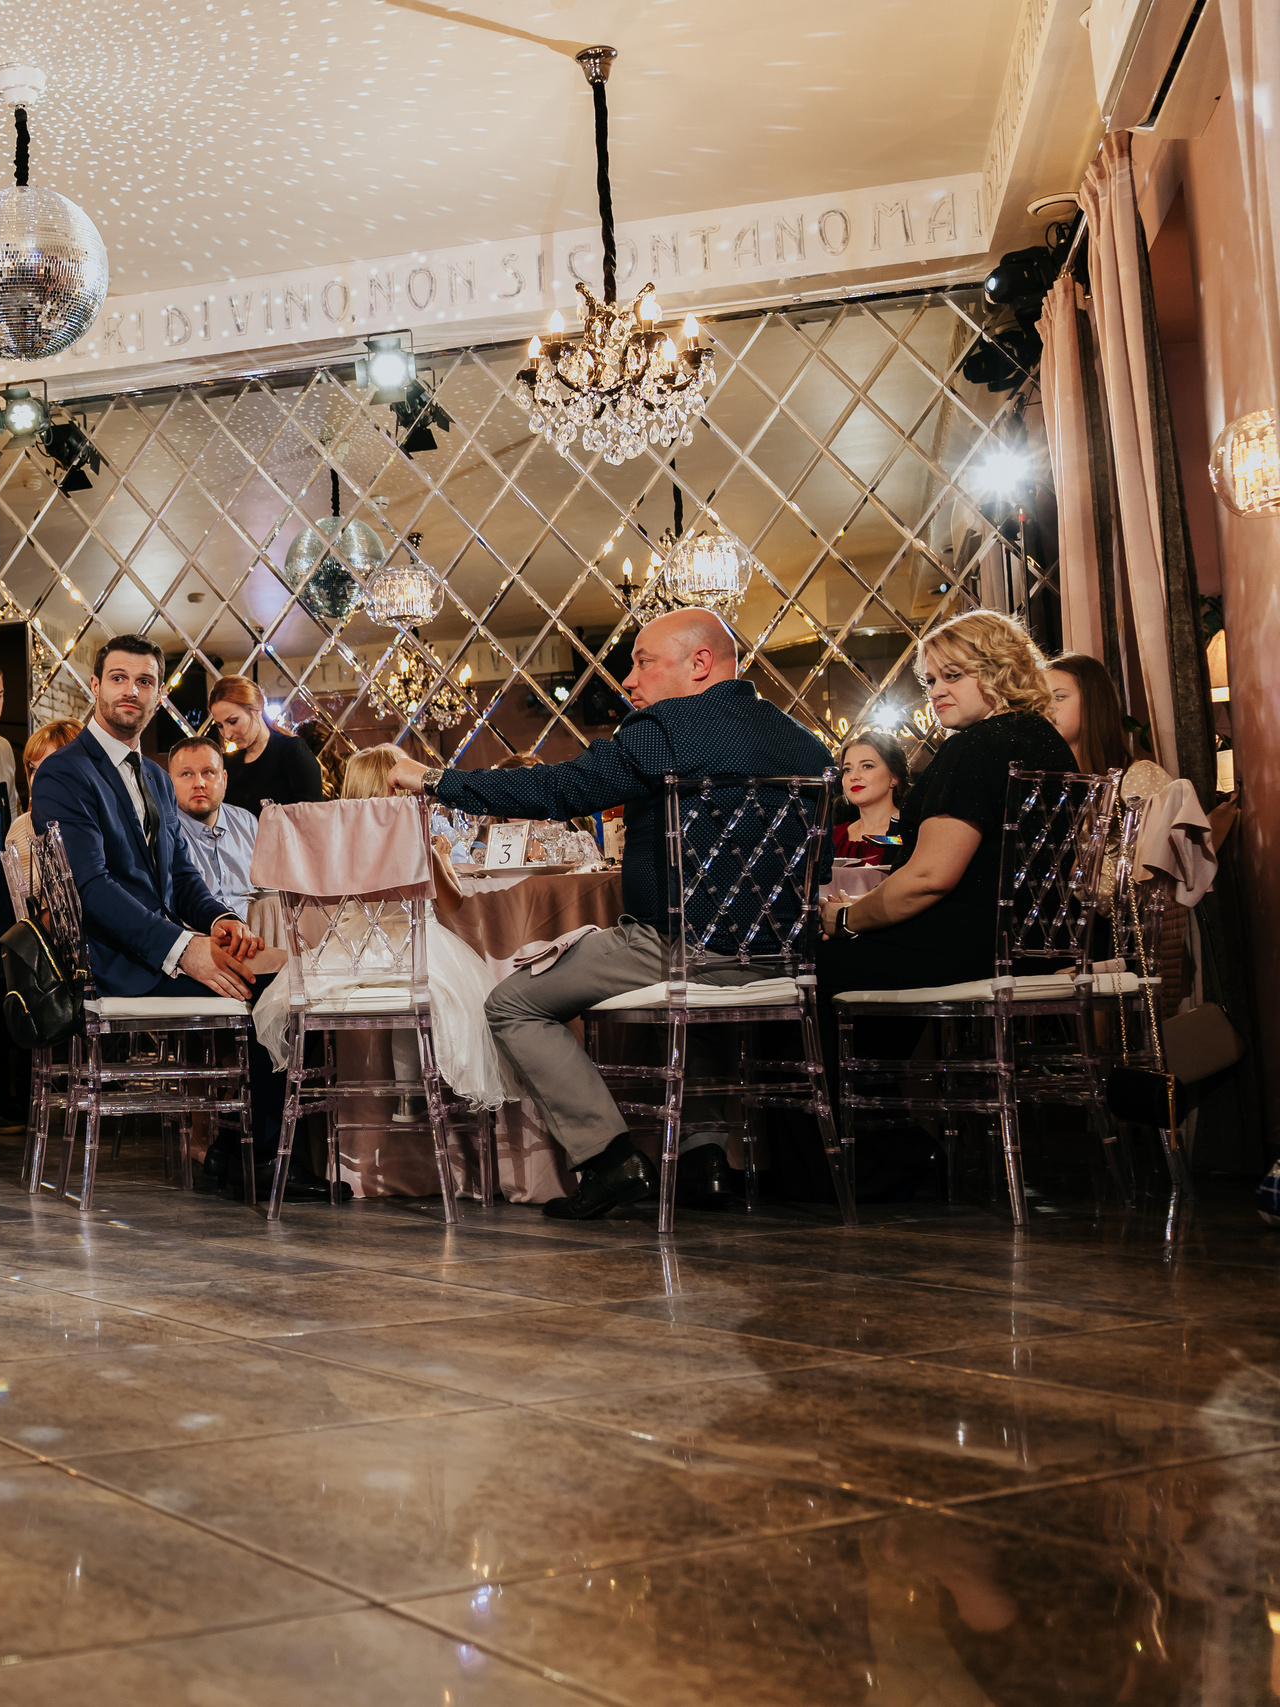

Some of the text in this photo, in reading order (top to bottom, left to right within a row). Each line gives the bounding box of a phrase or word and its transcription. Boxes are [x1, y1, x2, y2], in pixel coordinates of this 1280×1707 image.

[367, 260, 477, 319] NON
[497, 250, 547, 299] SI
[869, 189, 982, 252] MAI
[499, 843, 512, 865] 3
